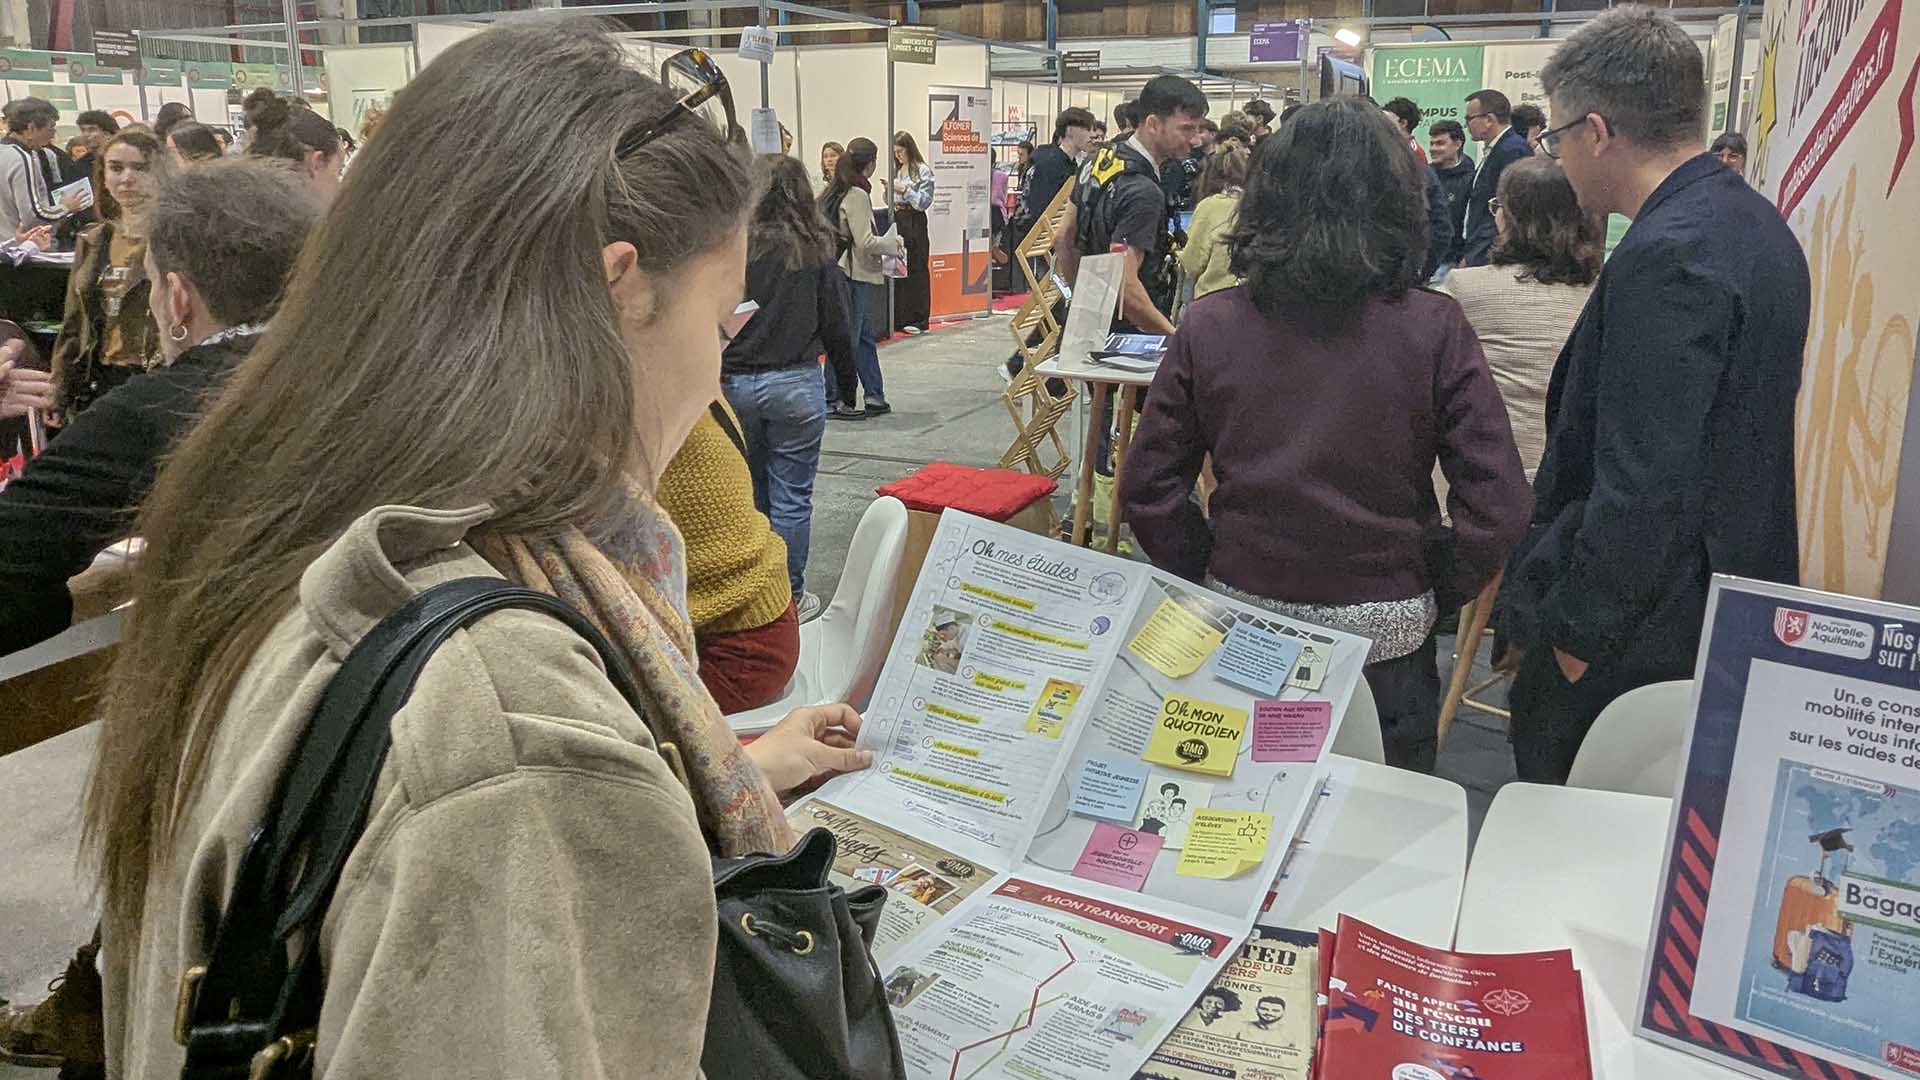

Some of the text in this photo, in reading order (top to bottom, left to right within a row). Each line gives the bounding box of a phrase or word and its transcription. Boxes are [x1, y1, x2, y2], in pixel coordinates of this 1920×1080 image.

[1385, 58, 1467, 78] ECEMA
[1419, 108, 1458, 118] MPUS
[944, 121, 970, 130] ILFOMER
[943, 133, 970, 142] Sciences
[972, 539, 994, 557] Oh
[994, 549, 1024, 566] mes
[1026, 551, 1079, 581] études
[1810, 631, 1865, 649] Aquitaine
[1811, 621, 1868, 638] Nouvelle-
[1881, 627, 1914, 650] Nos
[1878, 649, 1907, 669] sur
[1833, 687, 1873, 707] Un.e
[1165, 699, 1224, 724] Oh MON
[1805, 701, 1876, 725] mobilité
[1163, 717, 1240, 741] QUOTIDIEN
[1847, 726, 1888, 745] vous
[1788, 730, 1814, 745] sur
[1818, 735, 1842, 751] les
[1847, 743, 1896, 764] aides
[1846, 883, 1920, 923] Bagag
[1041, 894, 1169, 935] MON TRANSPORT
[1242, 944, 1297, 966] TED
[1225, 966, 1258, 978] IERS
[1231, 959, 1294, 976] ADEURS
[1376, 978, 1461, 1011] FAITES APPEL
[1091, 1003, 1107, 1012] AU
[1393, 997, 1492, 1027] au réseau
[1393, 1008, 1480, 1038] DES TIERS
[1392, 1020, 1523, 1052] DE CONFIANCE
